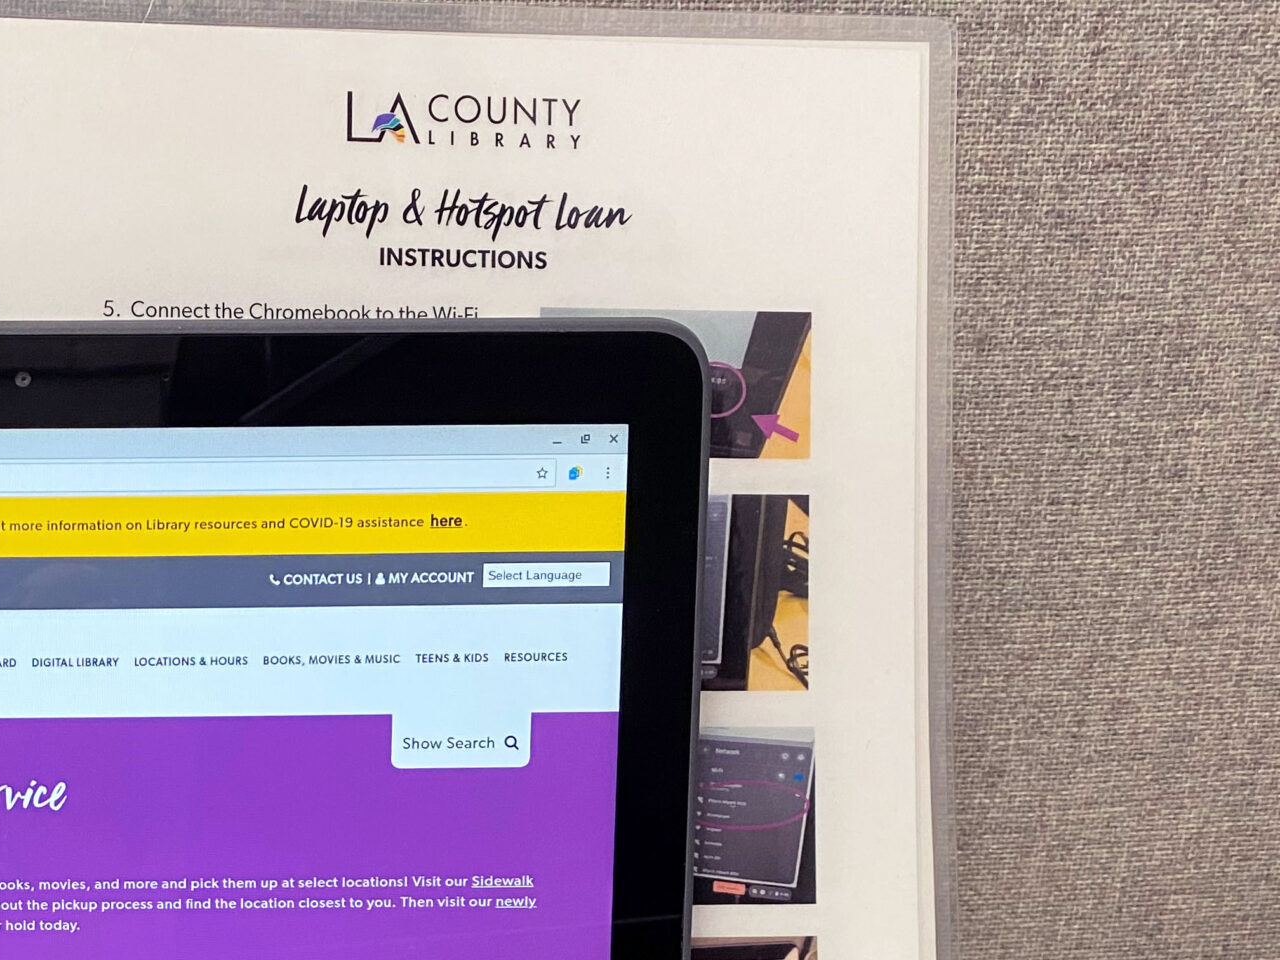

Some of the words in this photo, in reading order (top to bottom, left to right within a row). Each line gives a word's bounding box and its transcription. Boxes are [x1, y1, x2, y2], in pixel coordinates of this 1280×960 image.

[346, 90, 421, 145] LA
[428, 93, 581, 127] COUNTY
[428, 130, 582, 150] LIBRARY
[294, 184, 389, 240] Laptop
[402, 187, 426, 227] &
[434, 188, 551, 241] Hotspot
[554, 191, 633, 231] Loan
[379, 247, 548, 270] INSTRUCTIONS
[102, 299, 121, 318] 5.
[130, 300, 211, 319] Connect
[215, 301, 245, 319] the
[249, 302, 371, 319] Chromebook
[376, 306, 395, 319] to
[399, 305, 428, 318] the
[432, 305, 479, 318] Wi-Fi
[9, 522, 43, 531] more
[46, 519, 122, 531] information
[125, 522, 143, 531] on
[146, 518, 191, 534] Library
[194, 520, 258, 530] resources
[260, 517, 286, 529] and
[288, 516, 354, 529] COVID-19
[356, 516, 425, 528] assistance
[283, 572, 344, 586] CONTACT
[346, 573, 363, 585] US
[388, 572, 409, 584] MY
[410, 571, 475, 584] ACCOUNT
[488, 570, 523, 581] Select
[526, 569, 582, 584] Language
[31, 657, 74, 668] DIGITAL
[76, 657, 119, 668] LIBRARY
[134, 656, 196, 667] LOCATIONS
[198, 656, 207, 666] &
[210, 655, 249, 666] HOURS
[263, 654, 305, 667] BOOKS,
[308, 654, 351, 665] MOVIES
[354, 654, 362, 664] &
[364, 654, 401, 664] MUSIC
[415, 653, 450, 664] TEENS
[452, 653, 461, 664] &
[464, 652, 489, 664] KIDS
[504, 651, 568, 662] RESOURCES
[402, 737, 442, 750] Show
[446, 736, 495, 750] Search
[5, 919, 36, 931] hold
[38, 919, 81, 934] today.
